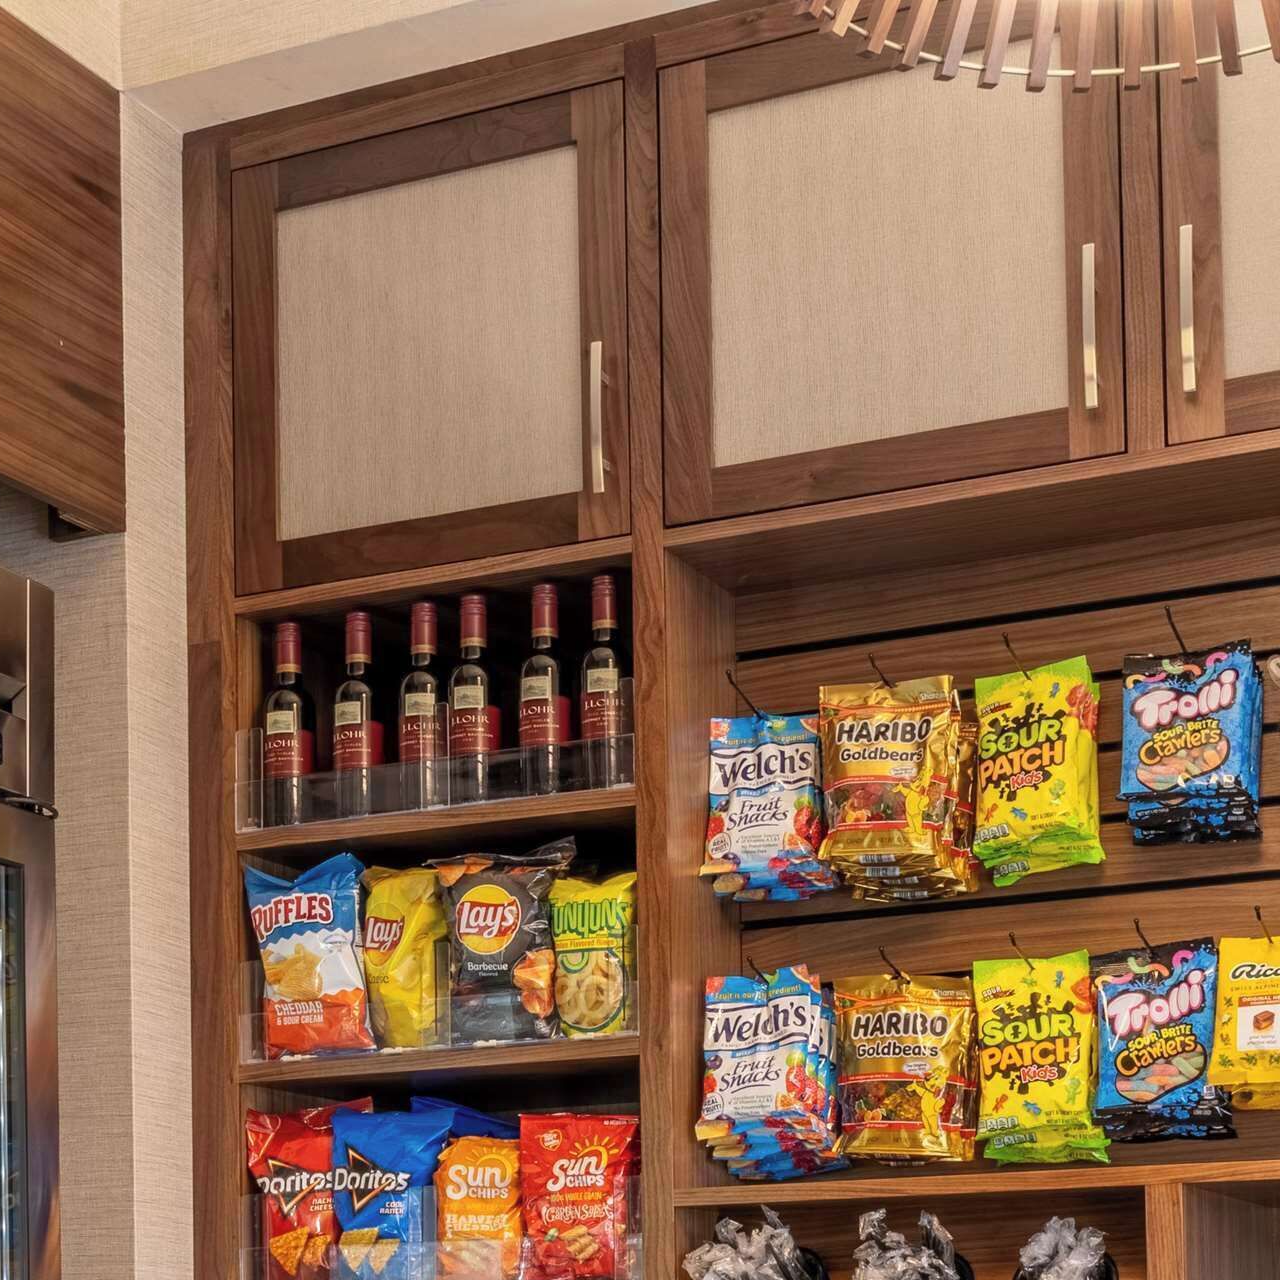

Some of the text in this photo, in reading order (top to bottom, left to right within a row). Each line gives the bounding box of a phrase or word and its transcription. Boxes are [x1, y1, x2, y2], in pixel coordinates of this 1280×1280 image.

[1133, 669, 1237, 728] Trolli
[836, 718, 932, 743] HARIBO
[981, 719, 1062, 759] SOUR
[1153, 721, 1218, 741] SOUR BRITE
[840, 749, 924, 763] Goldbears
[1139, 728, 1221, 765] Crawlers
[716, 749, 812, 787] Welch's
[980, 743, 1065, 787] PATCH
[1010, 771, 1043, 790] Kids
[739, 797, 781, 815] Fruit
[727, 809, 789, 831] Snacks
[251, 893, 332, 942] RUFFLES
[459, 901, 518, 939] Lay's
[365, 917, 403, 950] Lay's
[467, 962, 508, 971] Barbecue
[275, 1002, 323, 1015] CHEDDAR
[1108, 970, 1205, 1037] Trolli
[284, 1015, 324, 1025] SOUR CREAM
[712, 1003, 806, 1043] Welch's
[853, 1012, 948, 1036] HARIBO
[981, 1013, 1075, 1044] SOUR
[1128, 1024, 1192, 1051] SOUR BRITE
[733, 1056, 775, 1073] Fruit
[982, 1037, 1080, 1075] PATCH
[1116, 1035, 1196, 1076] Crawlers
[720, 1068, 781, 1091] Snacks
[1020, 1066, 1057, 1082] Kids
[334, 1170, 410, 1192] Doritos
[446, 1163, 512, 1200] Sun
[546, 1152, 607, 1192] Sun
[564, 1175, 605, 1188] CHIPS
[468, 1187, 509, 1199] CHIPS
